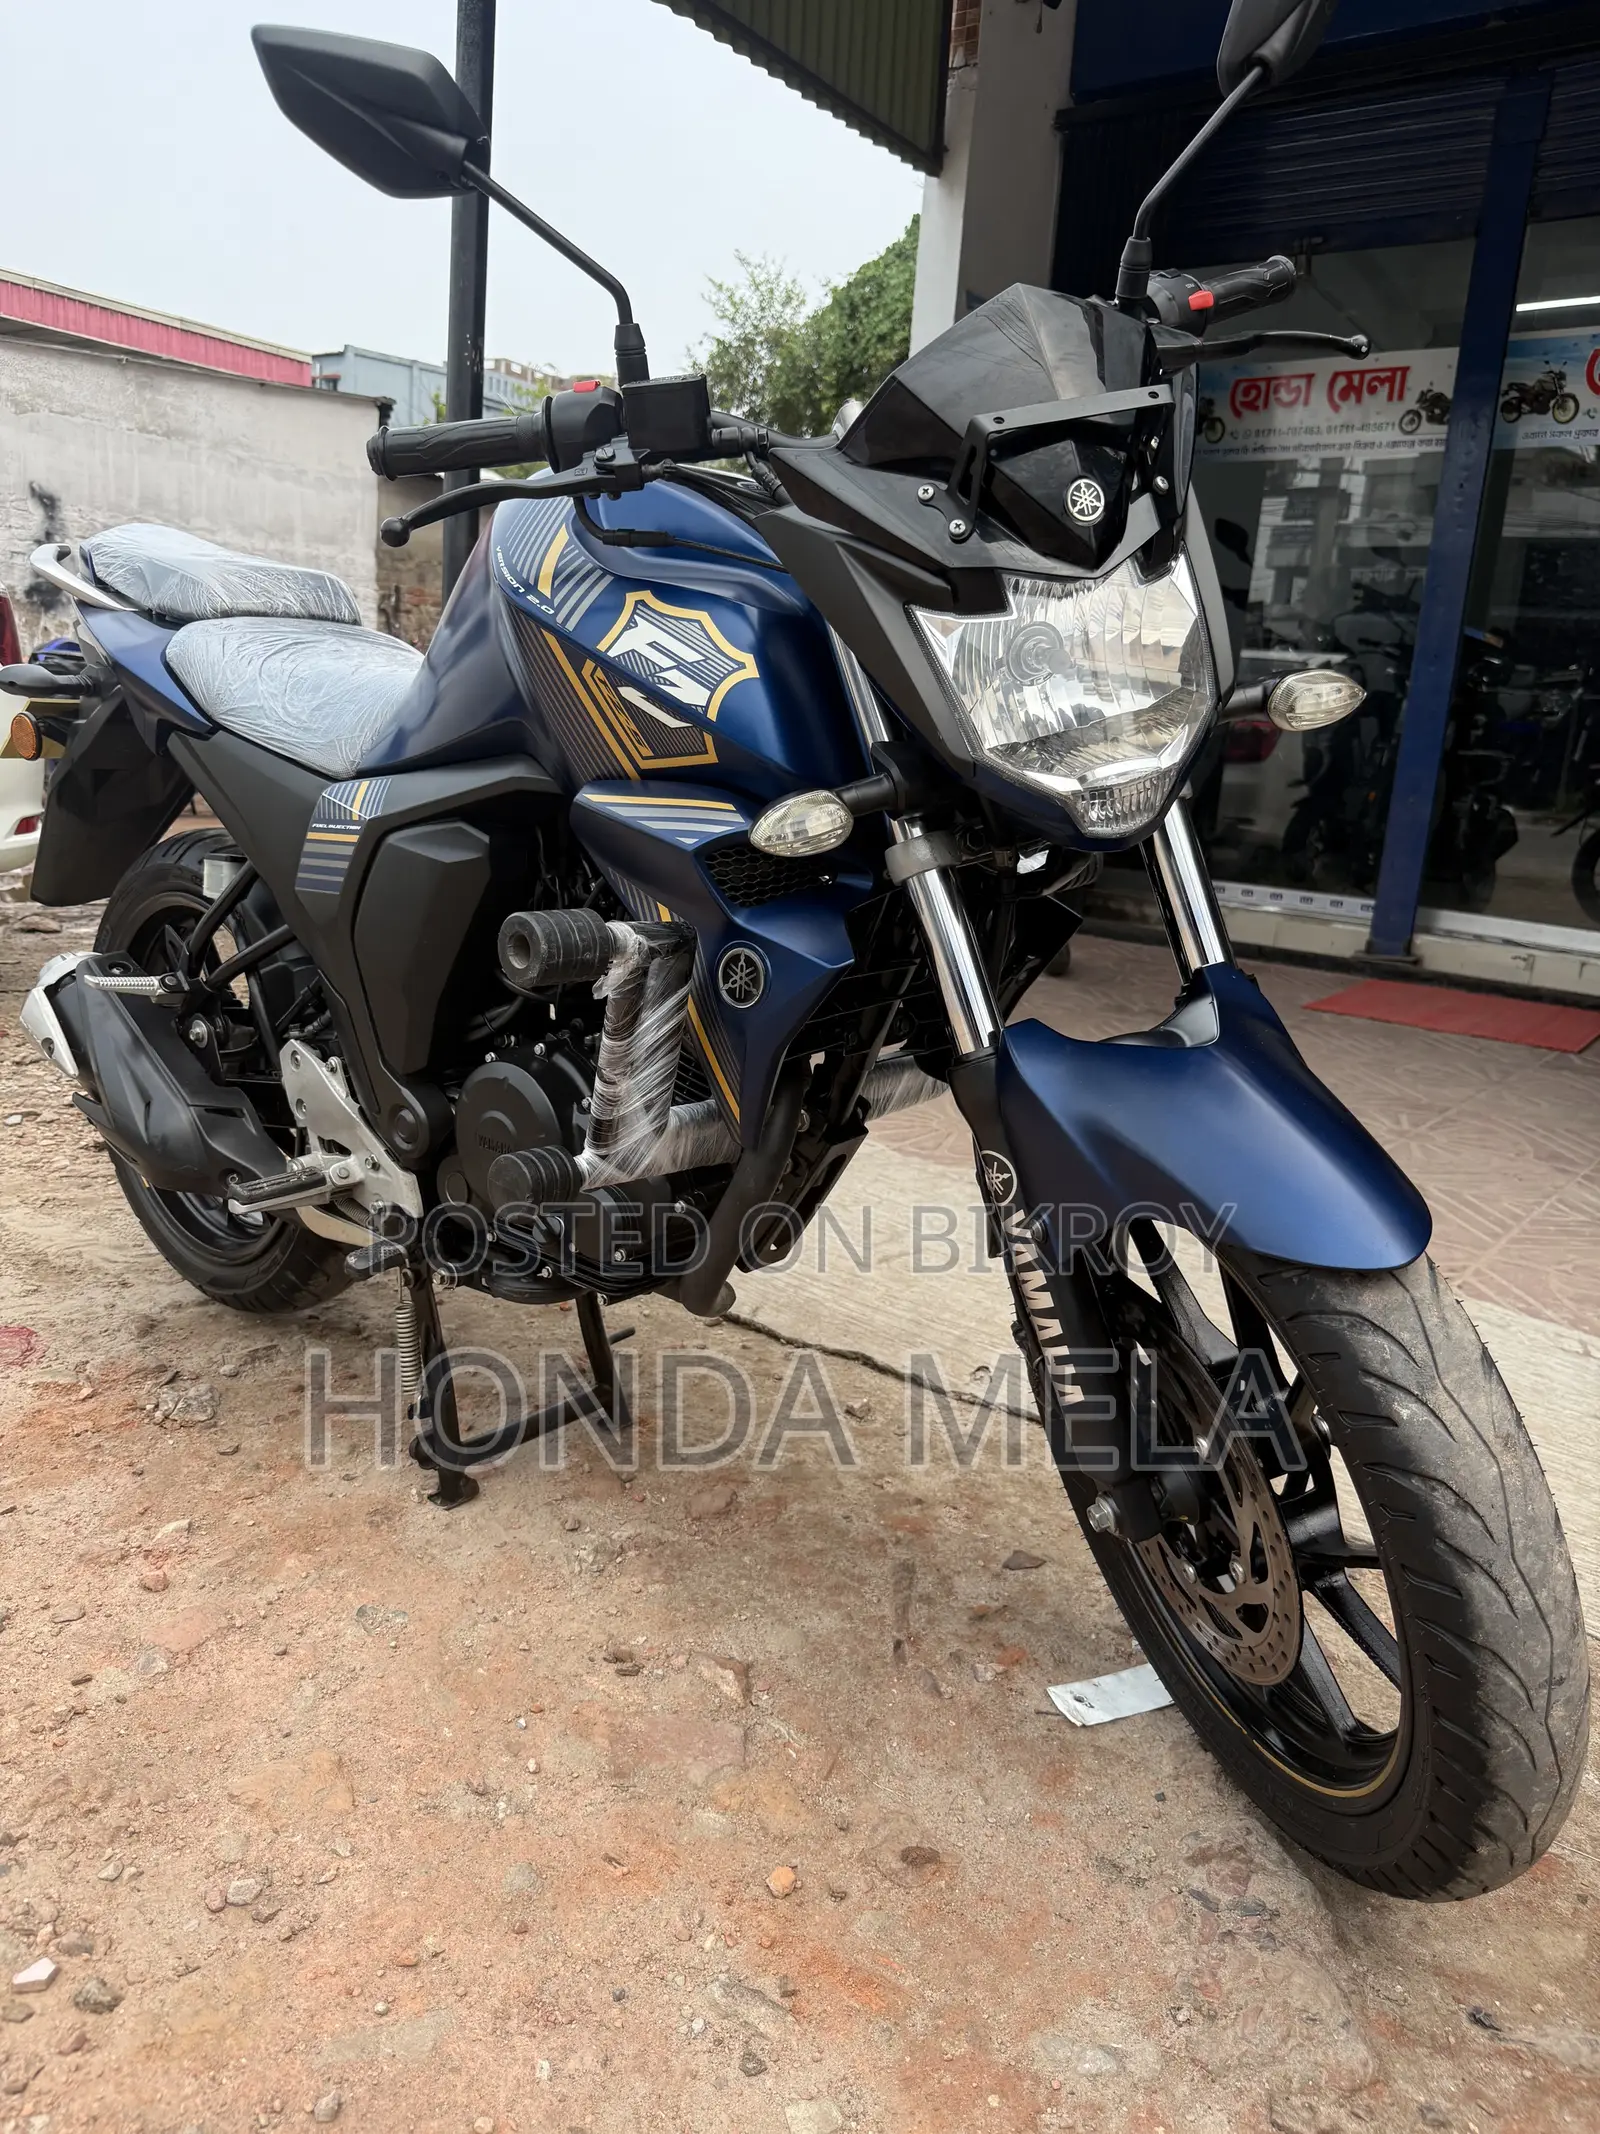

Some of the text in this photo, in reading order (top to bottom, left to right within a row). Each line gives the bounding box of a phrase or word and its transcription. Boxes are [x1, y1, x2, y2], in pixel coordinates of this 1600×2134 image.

[1229, 366, 1410, 419] হোন্ডা মেলা
[526, 594, 555, 615] 2.0
[1004, 1209, 1084, 1406] YAMAHA
